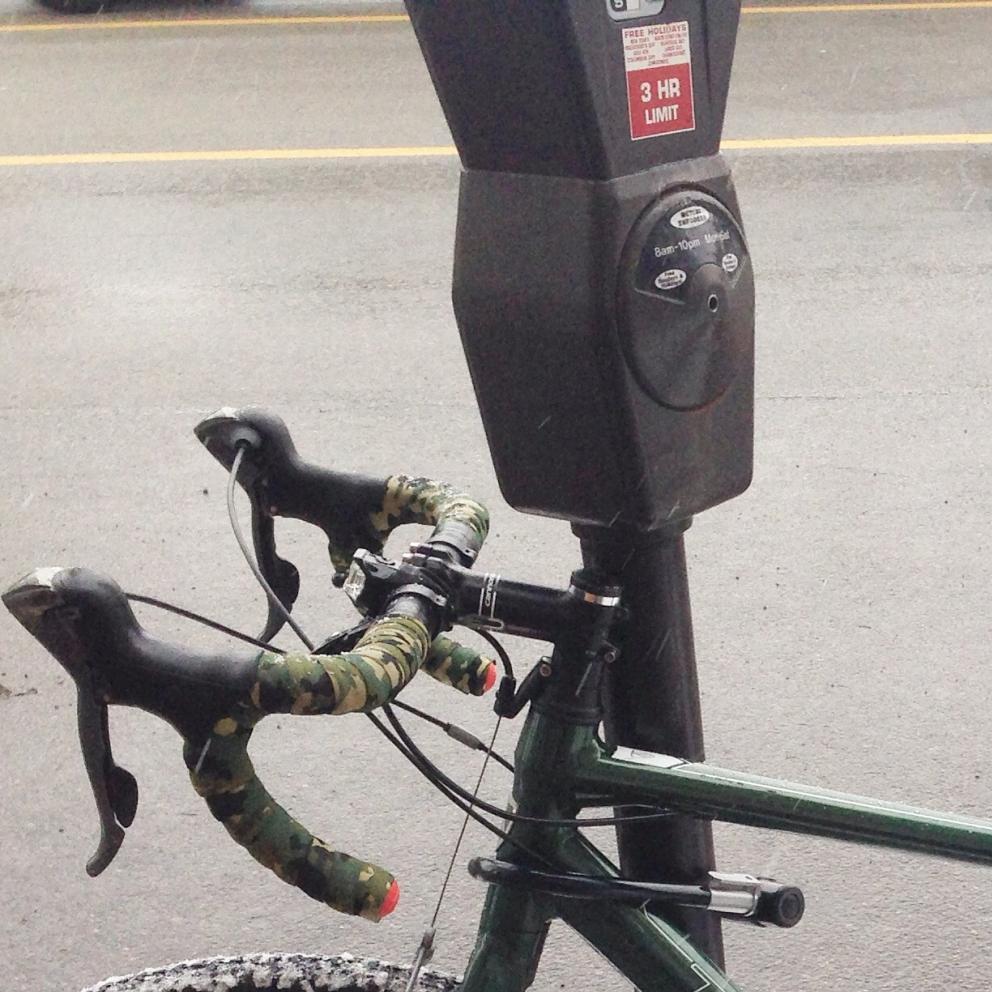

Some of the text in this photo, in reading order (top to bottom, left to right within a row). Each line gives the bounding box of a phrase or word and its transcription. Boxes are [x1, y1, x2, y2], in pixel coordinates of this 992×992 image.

[625, 23, 687, 38] FREE HOLIDAYS
[640, 78, 680, 102] 3 HR
[645, 104, 679, 124] LIMIT
